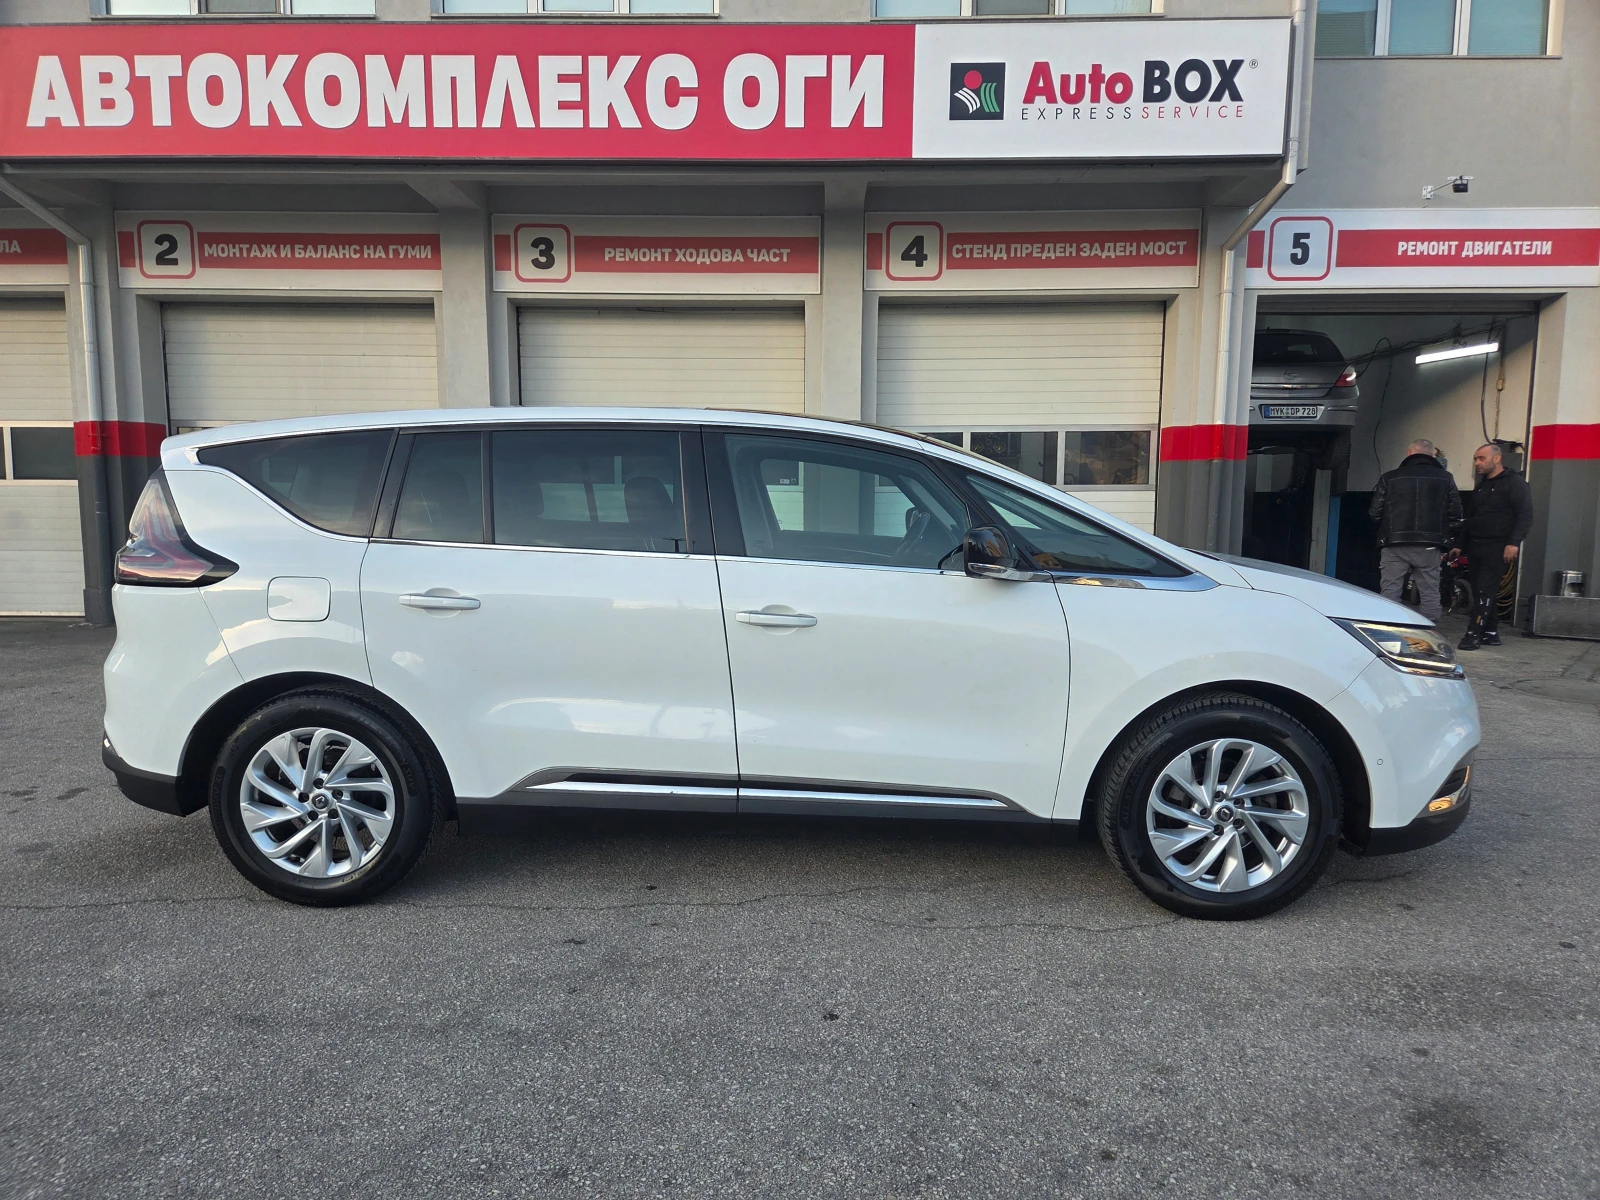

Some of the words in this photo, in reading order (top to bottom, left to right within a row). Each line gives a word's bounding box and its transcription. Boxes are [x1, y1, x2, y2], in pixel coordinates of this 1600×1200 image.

[27, 53, 699, 131] АВТОКОМПЛЕКС
[723, 53, 885, 130] ОГИ
[1022, 61, 1134, 105] Auto
[1143, 58, 1245, 104] BOX
[154, 233, 179, 266] 2
[204, 243, 277, 258] МОНТАЖ
[280, 243, 292, 259] И
[294, 244, 361, 259] БАЛАНС
[363, 244, 387, 259] НА
[389, 244, 432, 259] ГУМИ
[531, 236, 556, 270] 3
[604, 247, 673, 263] РЕМОНТ
[675, 247, 745, 265] ХОДОВА
[746, 247, 791, 263] ЧАСТ
[900, 235, 928, 268] 4
[951, 243, 1008, 261] СТЕНД
[1010, 242, 1077, 260] ПРЕДЕН
[1079, 241, 1137, 260] ЗАДЕН
[1140, 240, 1188, 256] МОСТ
[1288, 232, 1311, 266] 5
[1397, 240, 1459, 256] РЕМОНТ
[1462, 240, 1553, 258] ДВИГАТЕЛИ
[1301, 407, 1316, 416] 728
